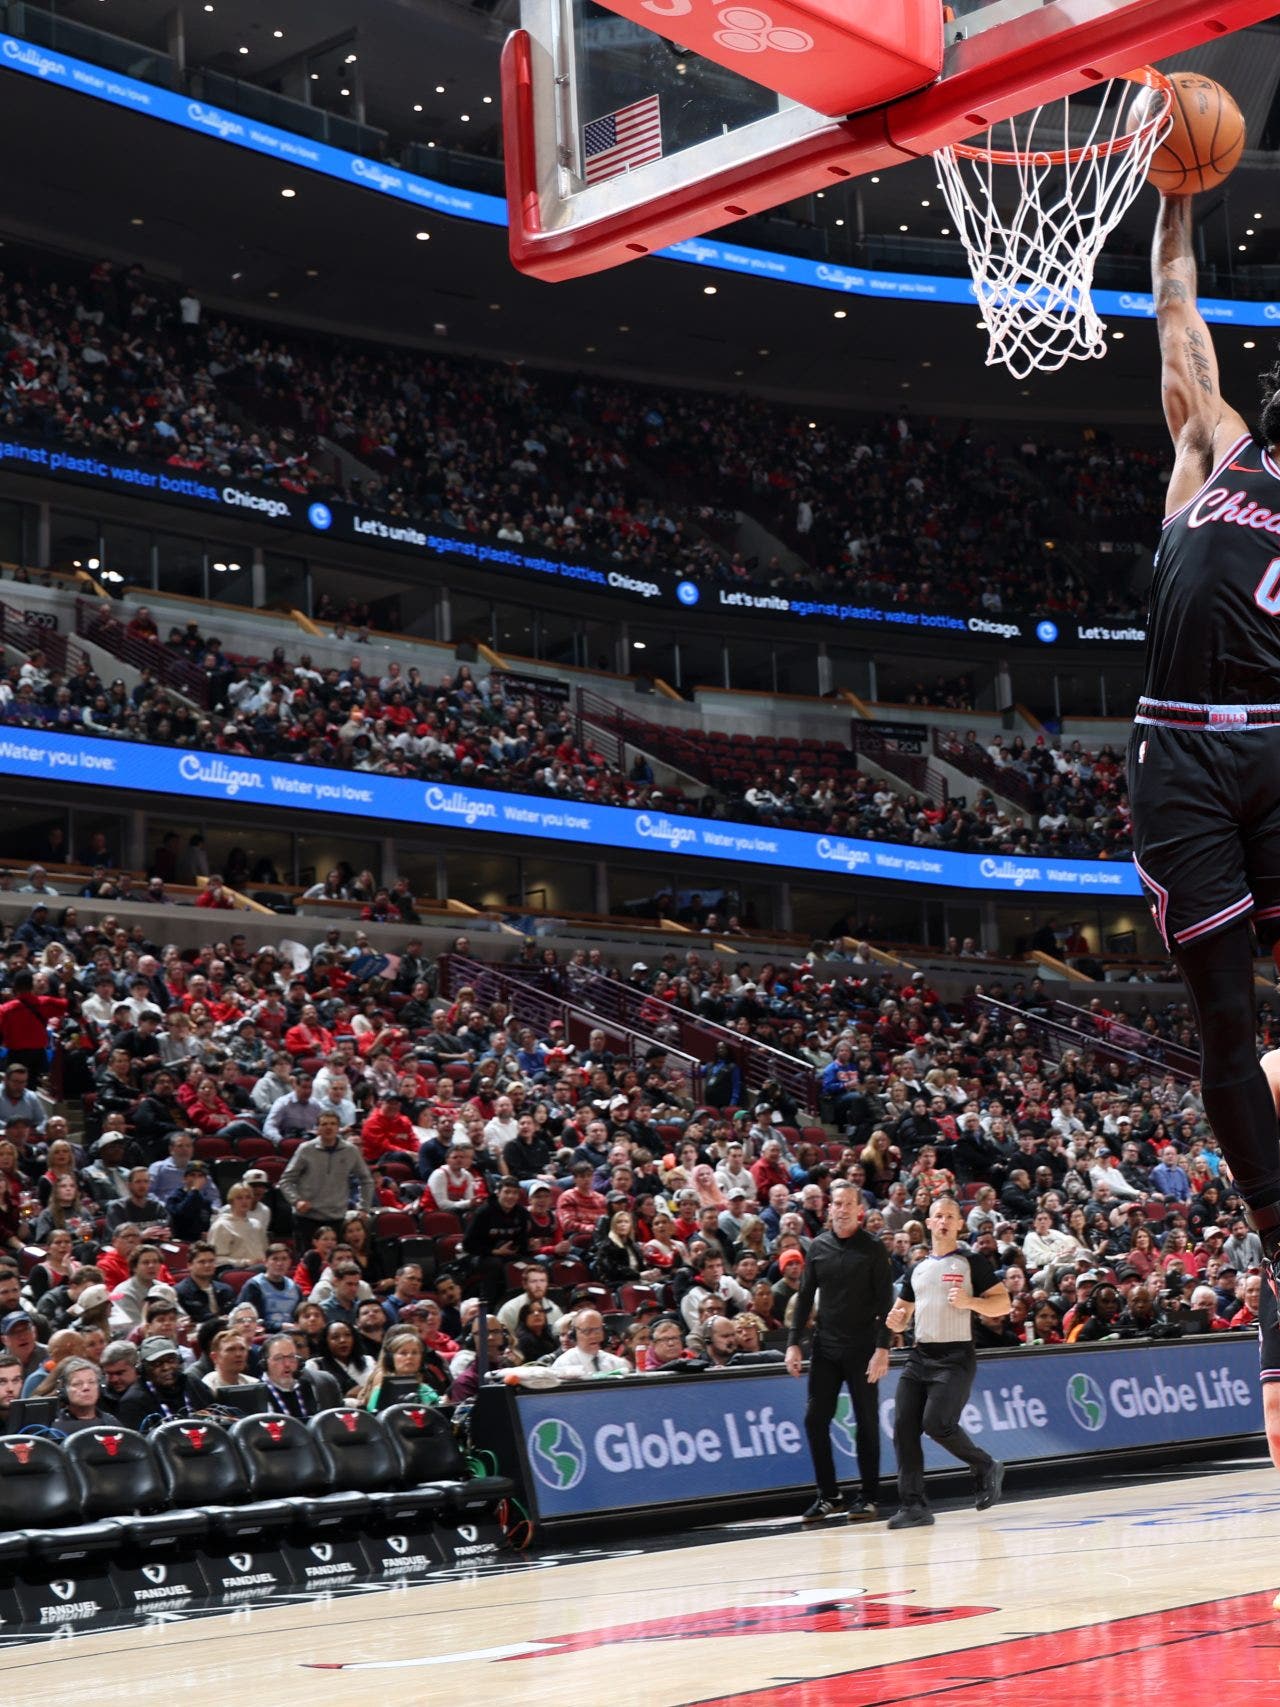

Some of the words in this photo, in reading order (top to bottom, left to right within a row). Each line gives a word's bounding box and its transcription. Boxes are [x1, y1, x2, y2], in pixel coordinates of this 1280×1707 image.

[3, 40, 65, 75] Culligan
[188, 103, 243, 136] Culligan
[352, 159, 401, 190] Culligan
[817, 265, 864, 289] Culligan
[50, 453, 108, 476] plastic
[111, 468, 157, 486] water
[160, 475, 219, 500] bottles.
[223, 488, 290, 517] Chicago.
[354, 517, 388, 537] Let's
[389, 528, 426, 545] unite
[427, 536, 477, 556] against
[478, 547, 522, 566] plastic
[523, 558, 559, 573] water
[560, 563, 606, 584] bottles.
[608, 572, 661, 597] Chicago.
[720, 591, 753, 606] Let's
[754, 596, 789, 610] unite
[790, 601, 839, 616] against
[840, 606, 882, 620] plastic
[884, 612, 919, 624] water
[920, 614, 966, 630] bottles.
[968, 618, 1020, 638] Chicago.
[1078, 627, 1110, 639] Let's
[1109, 627, 1145, 641] unite
[1211, 713, 1245, 723] BULLS
[48, 752, 77, 766] you
[179, 755, 263, 795] Culligan
[272, 777, 313, 794] Water
[315, 785, 341, 798] you
[425, 787, 496, 824] Culligan
[504, 807, 540, 822] Water
[541, 815, 563, 826] you
[636, 815, 696, 848] Culligan
[703, 832, 734, 846] Water
[735, 839, 754, 850] you
[817, 838, 870, 870] Culligan
[876, 855, 903, 867] Water
[904, 860, 920, 870] you
[980, 858, 1040, 887] Culligan
[1047, 870, 1078, 881] Water
[1079, 873, 1098, 884] you
[982, 1385, 1048, 1431] Life
[1109, 1377, 1204, 1421] Globe
[1206, 1366, 1252, 1407] Life
[594, 1421, 722, 1473] Globe
[724, 1405, 801, 1458] Life
[305, 1562, 357, 1577] FANDUEL
[381, 1555, 431, 1568] FANDUEL
[134, 1584, 193, 1600] FANDUEL
[222, 1572, 278, 1587] FANDUEL
[40, 1600, 102, 1616] FANDUEL
